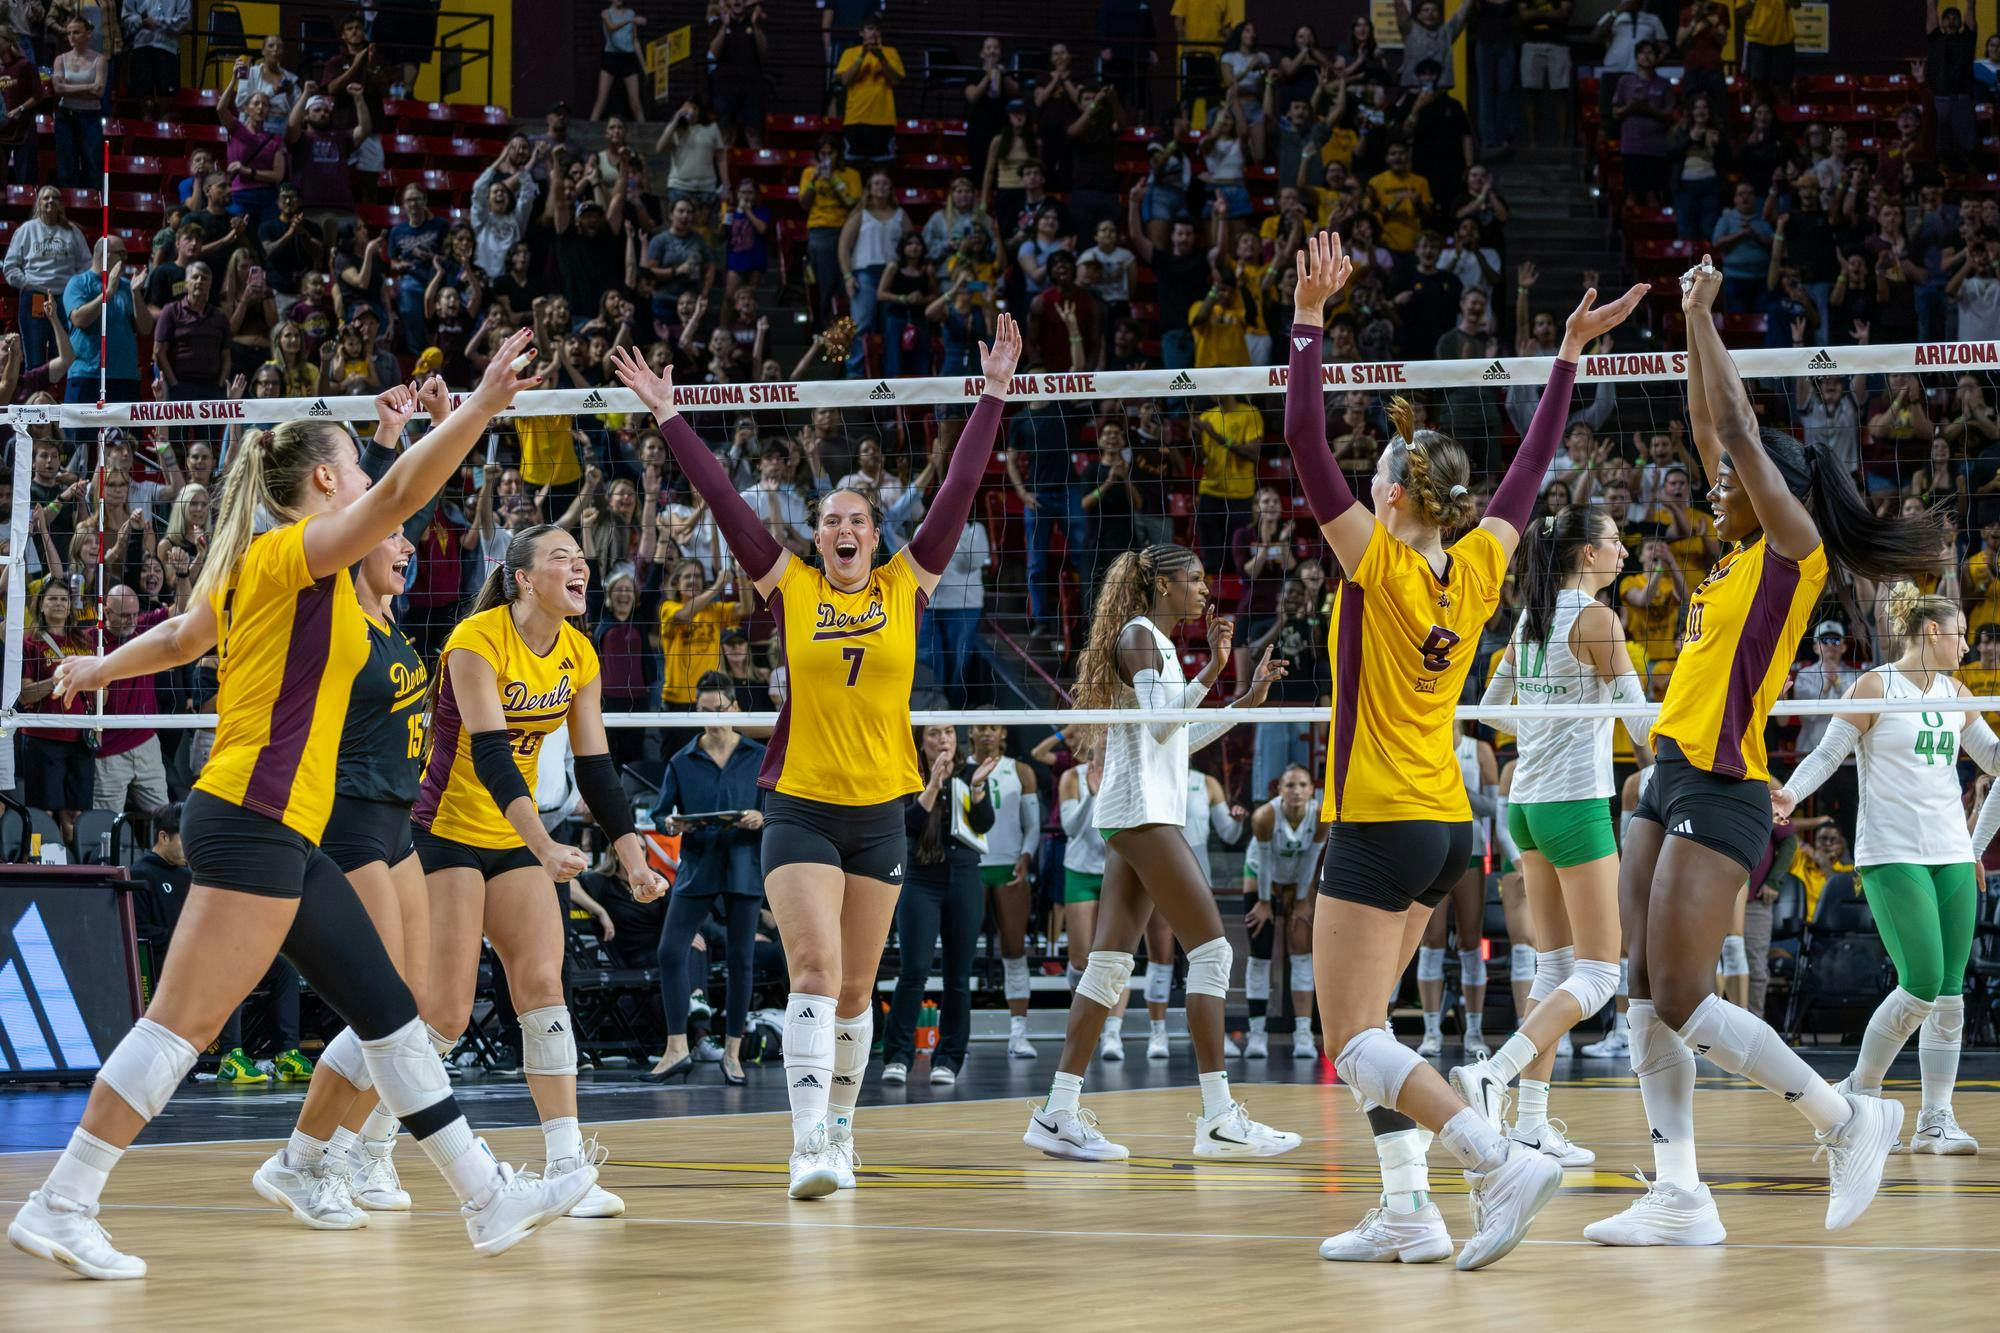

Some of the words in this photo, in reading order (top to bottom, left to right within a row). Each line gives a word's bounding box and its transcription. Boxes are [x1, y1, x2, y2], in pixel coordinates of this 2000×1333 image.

[1585, 354, 1667, 376] ARIZONA
[1808, 360, 1837, 370] adidas
[1914, 343, 1999, 366] ARIZONA
[964, 374, 1040, 397] ARONA
[1044, 373, 1097, 394] STATE
[1268, 365, 1347, 387] ARNA
[1352, 363, 1407, 385] STATE
[1482, 371, 1511, 380] adidas
[673, 384, 745, 406] ARIZONA
[749, 383, 800, 404] STATE
[869, 390, 896, 400] adidas
[1169, 382, 1197, 391] adidas
[129, 402, 195, 421] ARIZONA
[199, 400, 245, 419] STATE
[308, 408, 333, 417] adidas
[582, 400, 608, 409] adidas
[815, 600, 885, 629] Devils
[842, 646, 866, 688] 7
[502, 674, 573, 713] Devils
[1914, 730, 1955, 766] 44
